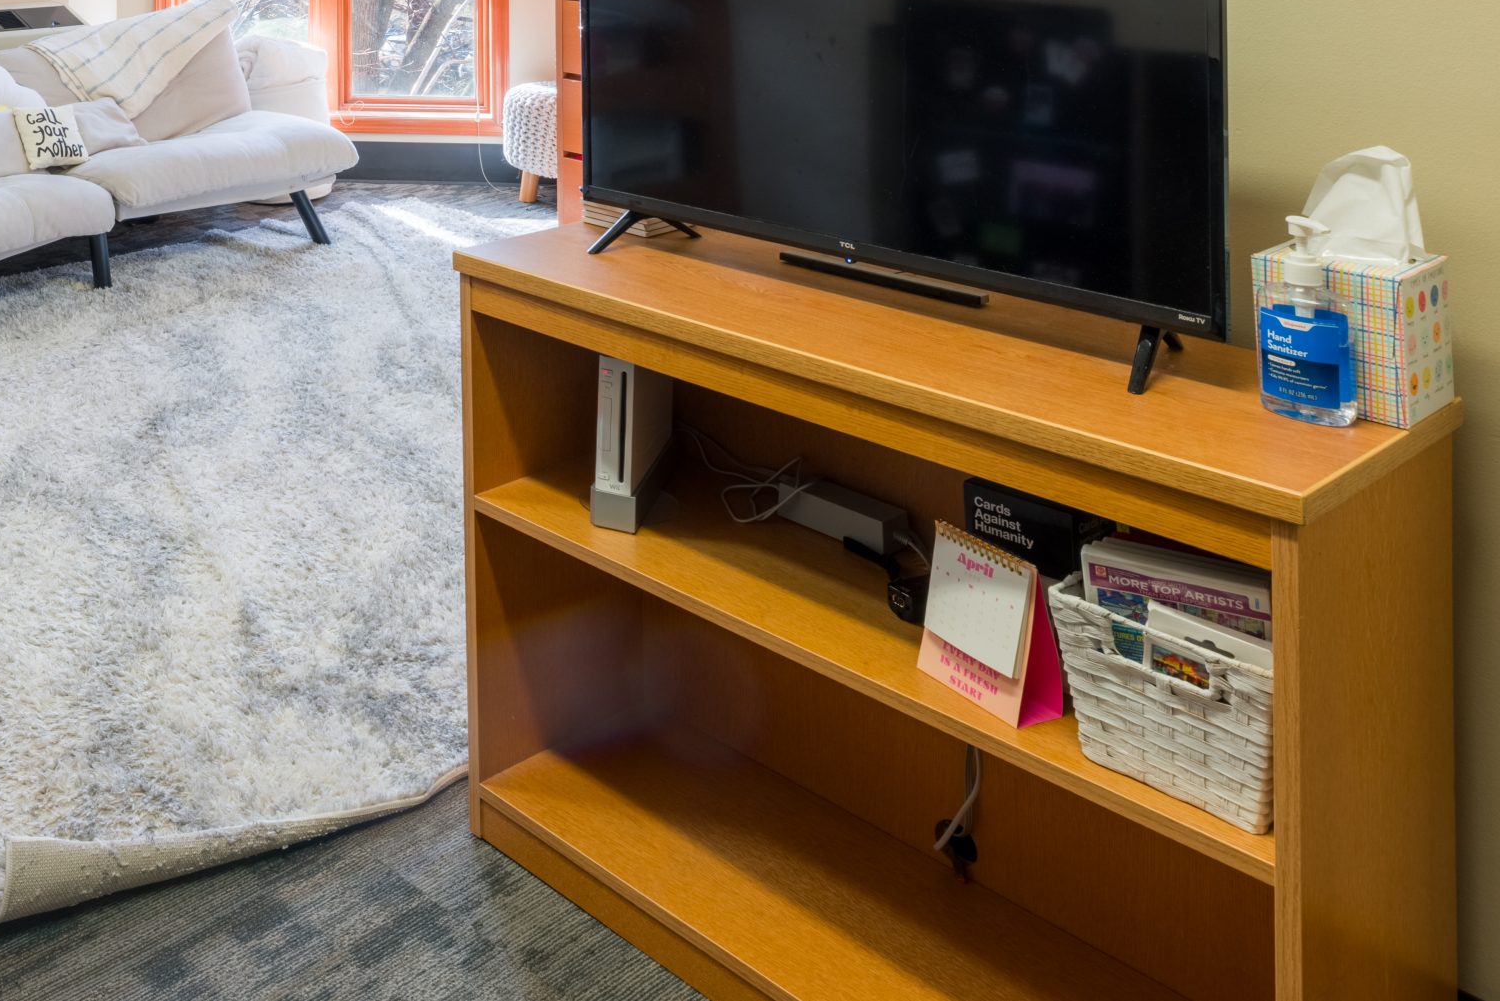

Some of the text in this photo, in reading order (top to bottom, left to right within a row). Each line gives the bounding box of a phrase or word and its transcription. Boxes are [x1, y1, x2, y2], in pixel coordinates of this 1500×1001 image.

[26, 108, 63, 126] call
[33, 125, 70, 146] your
[37, 138, 84, 158] mother
[839, 241, 855, 250] TCL
[1196, 317, 1206, 325] TV
[1267, 328, 1292, 344] Hand
[1267, 339, 1309, 358] Sanitizer
[974, 496, 1012, 517] Cards
[974, 508, 1022, 533] Against
[974, 519, 1035, 550] Humanity
[957, 552, 995, 579] April
[1108, 575, 1149, 591] MORE
[1152, 584, 1181, 596] TOP
[1185, 590, 1244, 611] ARTISTS
[941, 654, 998, 695] IS A FRESH
[978, 663, 999, 680] DAY
[949, 675, 982, 701] START
